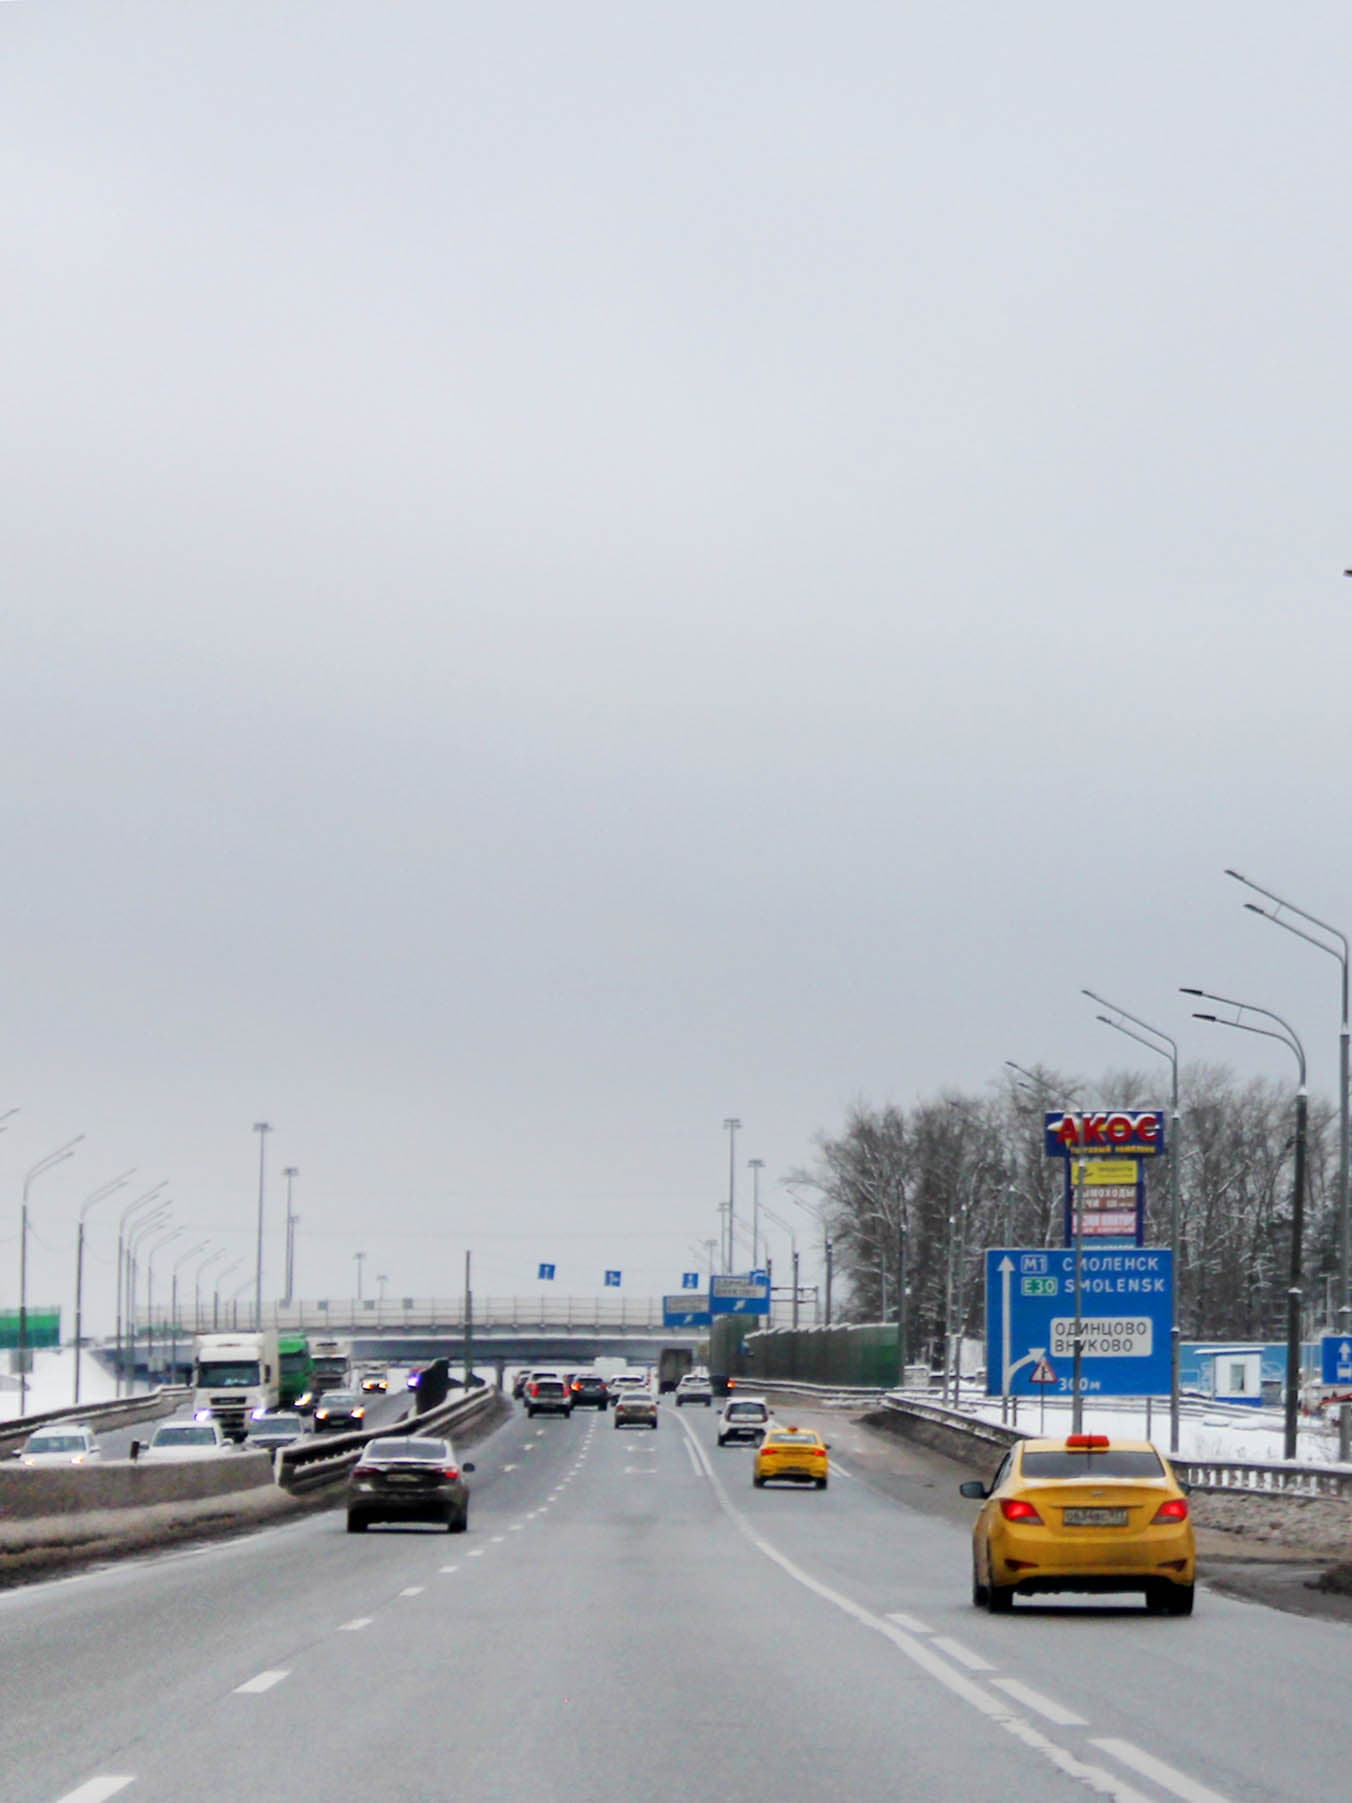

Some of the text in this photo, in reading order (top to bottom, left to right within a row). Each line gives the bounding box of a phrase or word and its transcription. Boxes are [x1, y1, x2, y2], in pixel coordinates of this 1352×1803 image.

[1023, 1257, 1045, 1271] М1
[1023, 1279, 1056, 1293] E30
[1064, 1279, 1165, 1293] SMOLENSK
[1055, 1322, 1147, 1337] ОДИНЦОВО
